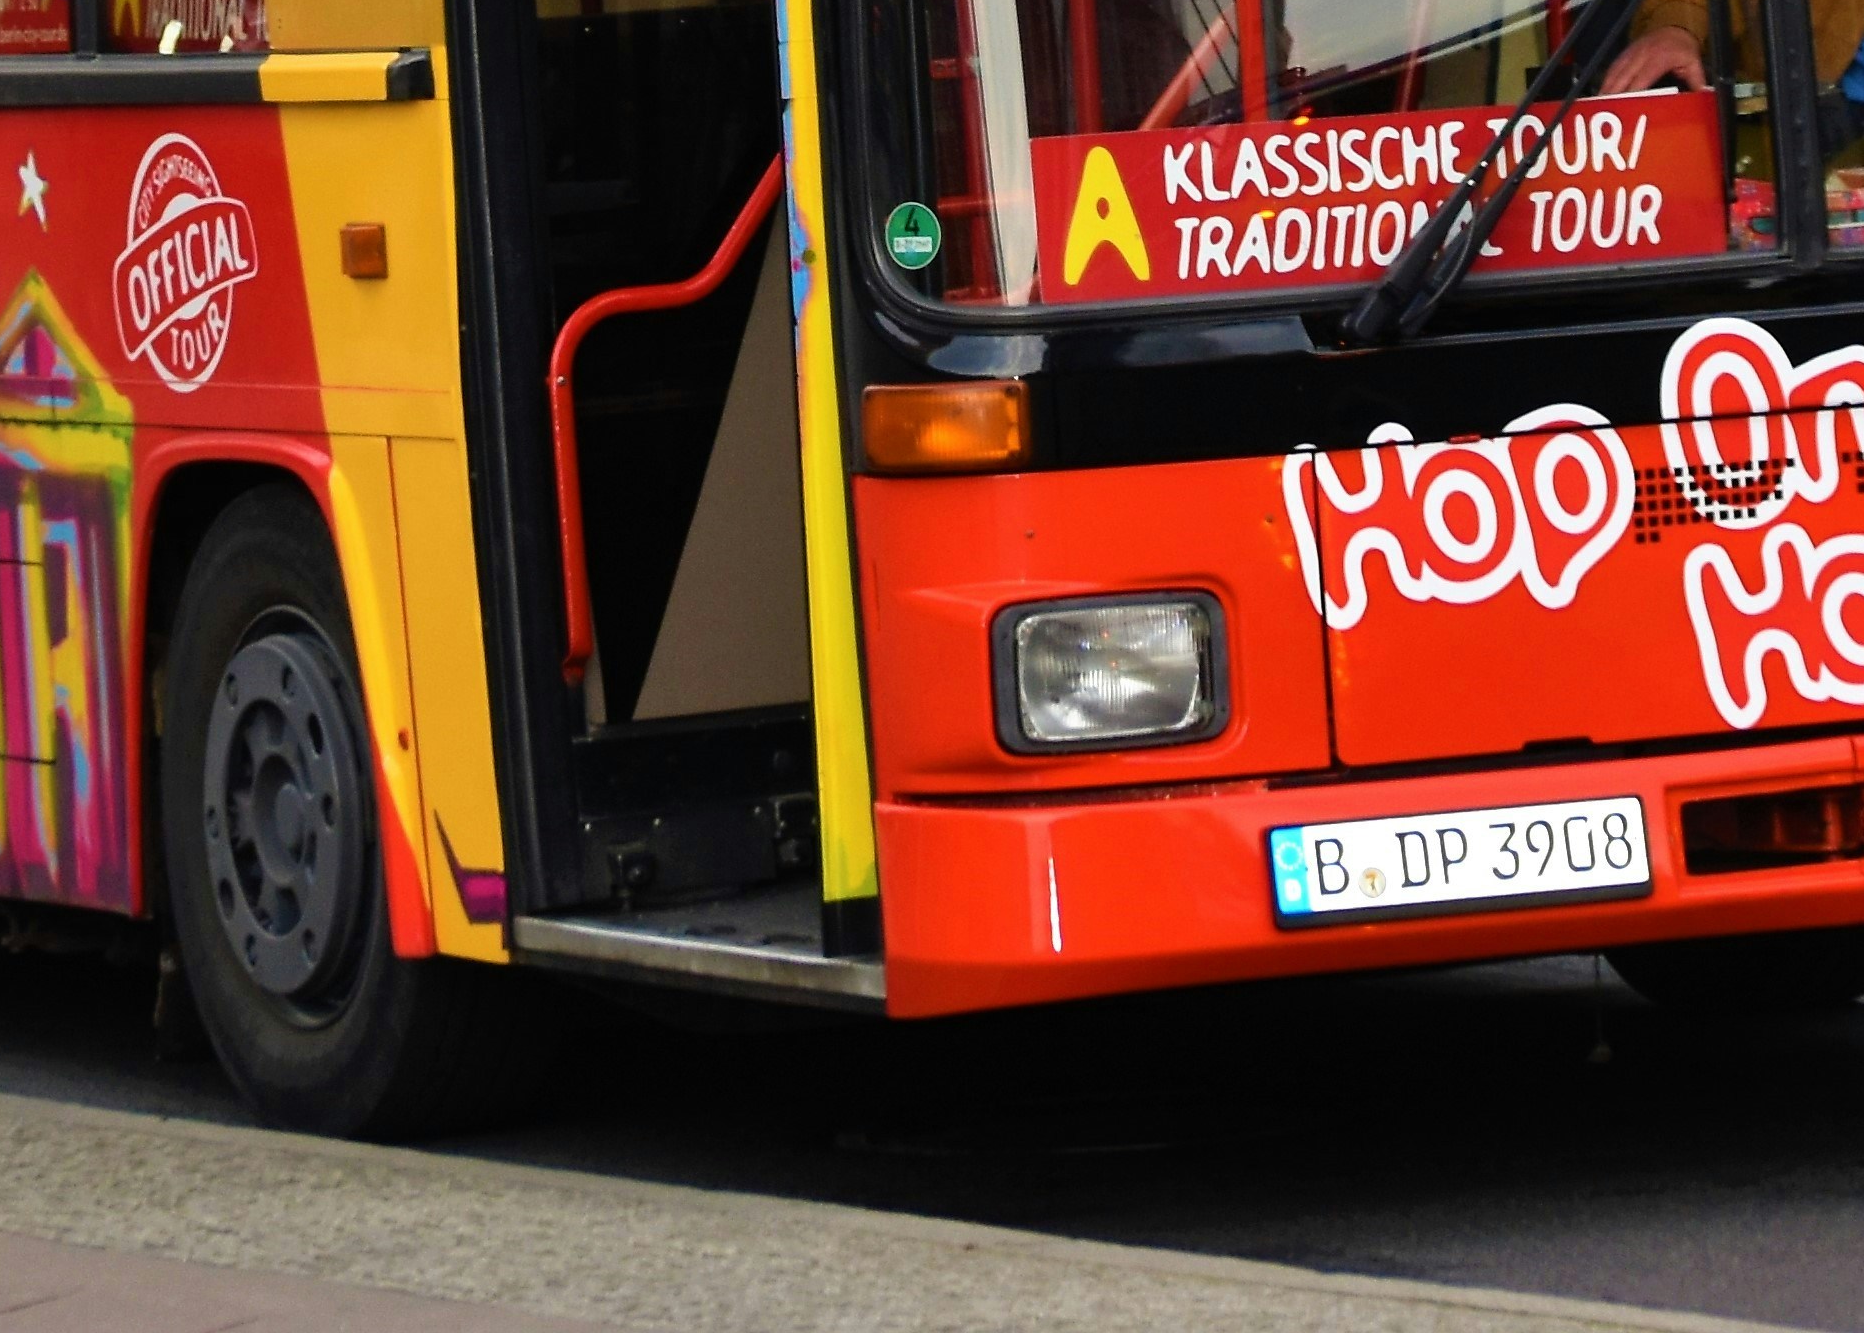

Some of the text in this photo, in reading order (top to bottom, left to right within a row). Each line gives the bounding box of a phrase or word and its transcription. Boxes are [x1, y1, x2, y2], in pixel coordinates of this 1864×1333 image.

[1163, 120, 1467, 204] KLASSISCHE
[904, 207, 921, 237] 4
[1062, 145, 1151, 286] A
[1528, 183, 1665, 253] TOUR
[128, 212, 249, 332] OFFICIAL
[169, 301, 226, 372] TOUR
[1282, 402, 1633, 630] Hop
[1313, 811, 1634, 897] B DP 3908
